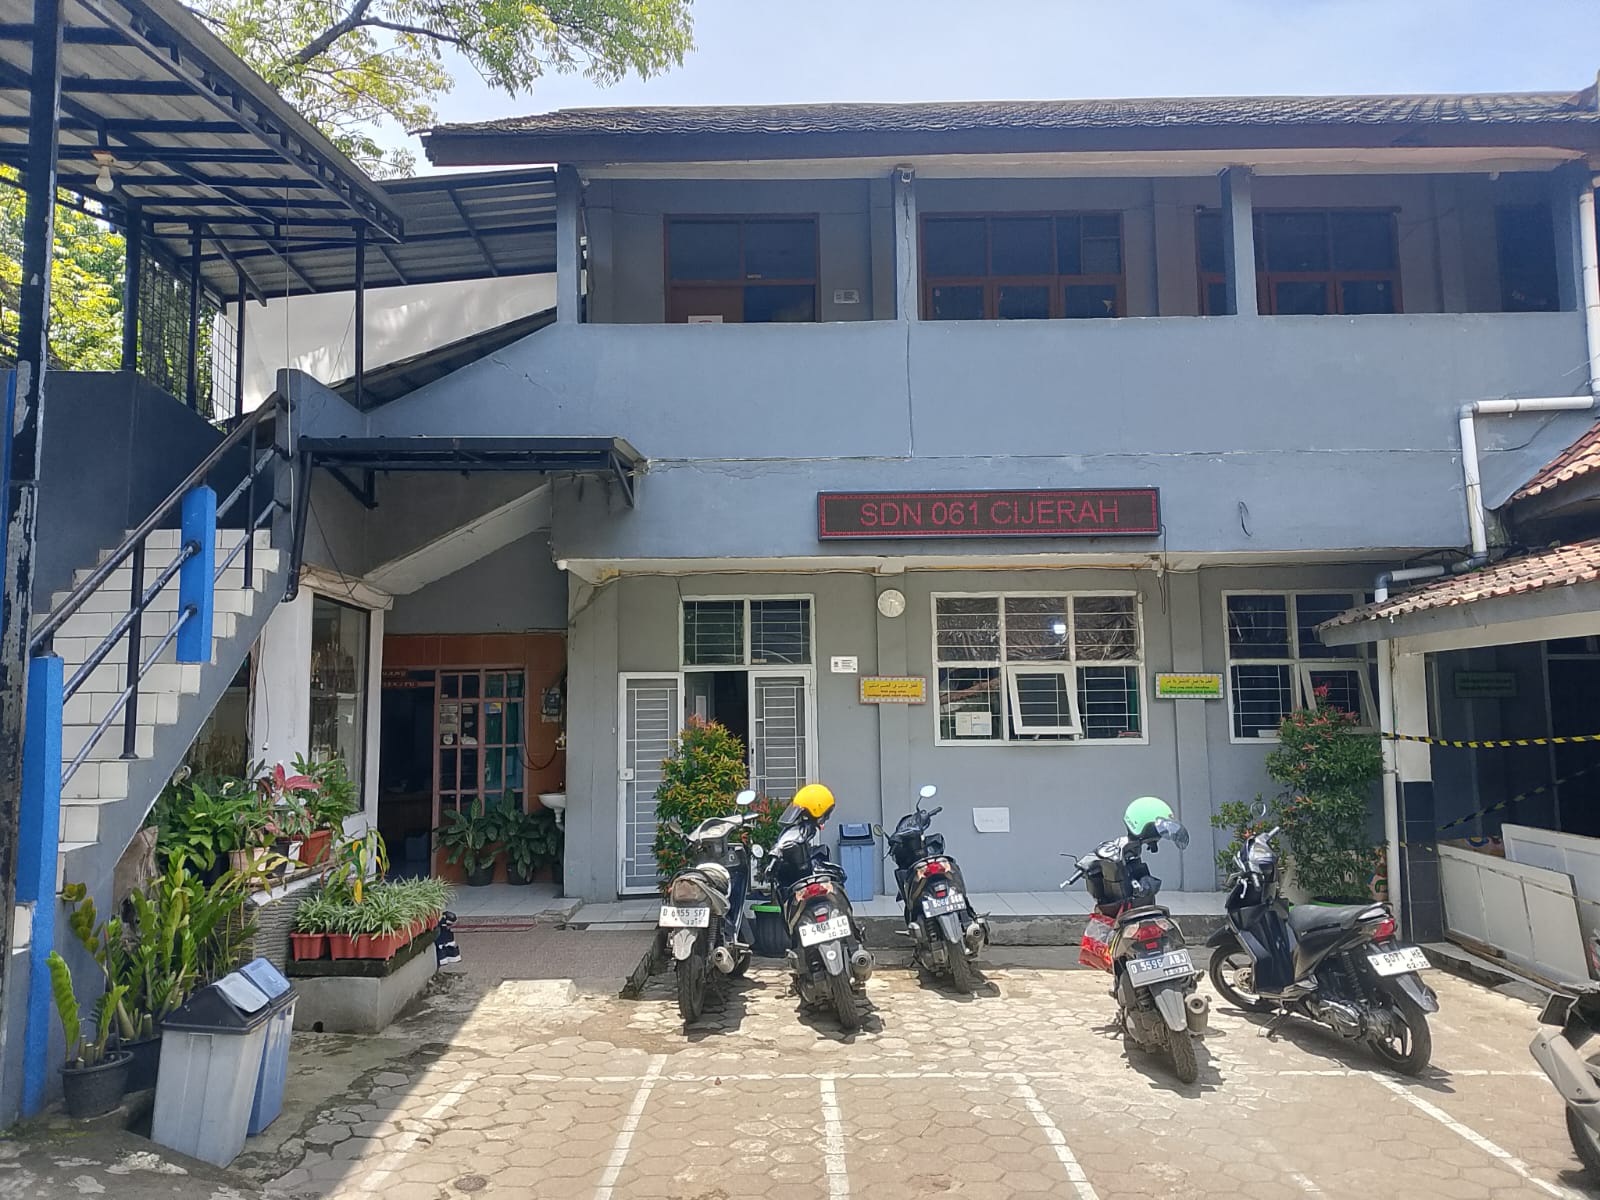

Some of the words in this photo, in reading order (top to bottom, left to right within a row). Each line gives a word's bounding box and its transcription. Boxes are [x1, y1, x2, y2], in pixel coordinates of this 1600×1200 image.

[860, 502, 922, 527] SDN
[931, 501, 979, 526] 061
[990, 499, 1120, 526] CIJERAH
[801, 928, 807, 937] D
[1169, 953, 1187, 965] ABJ
